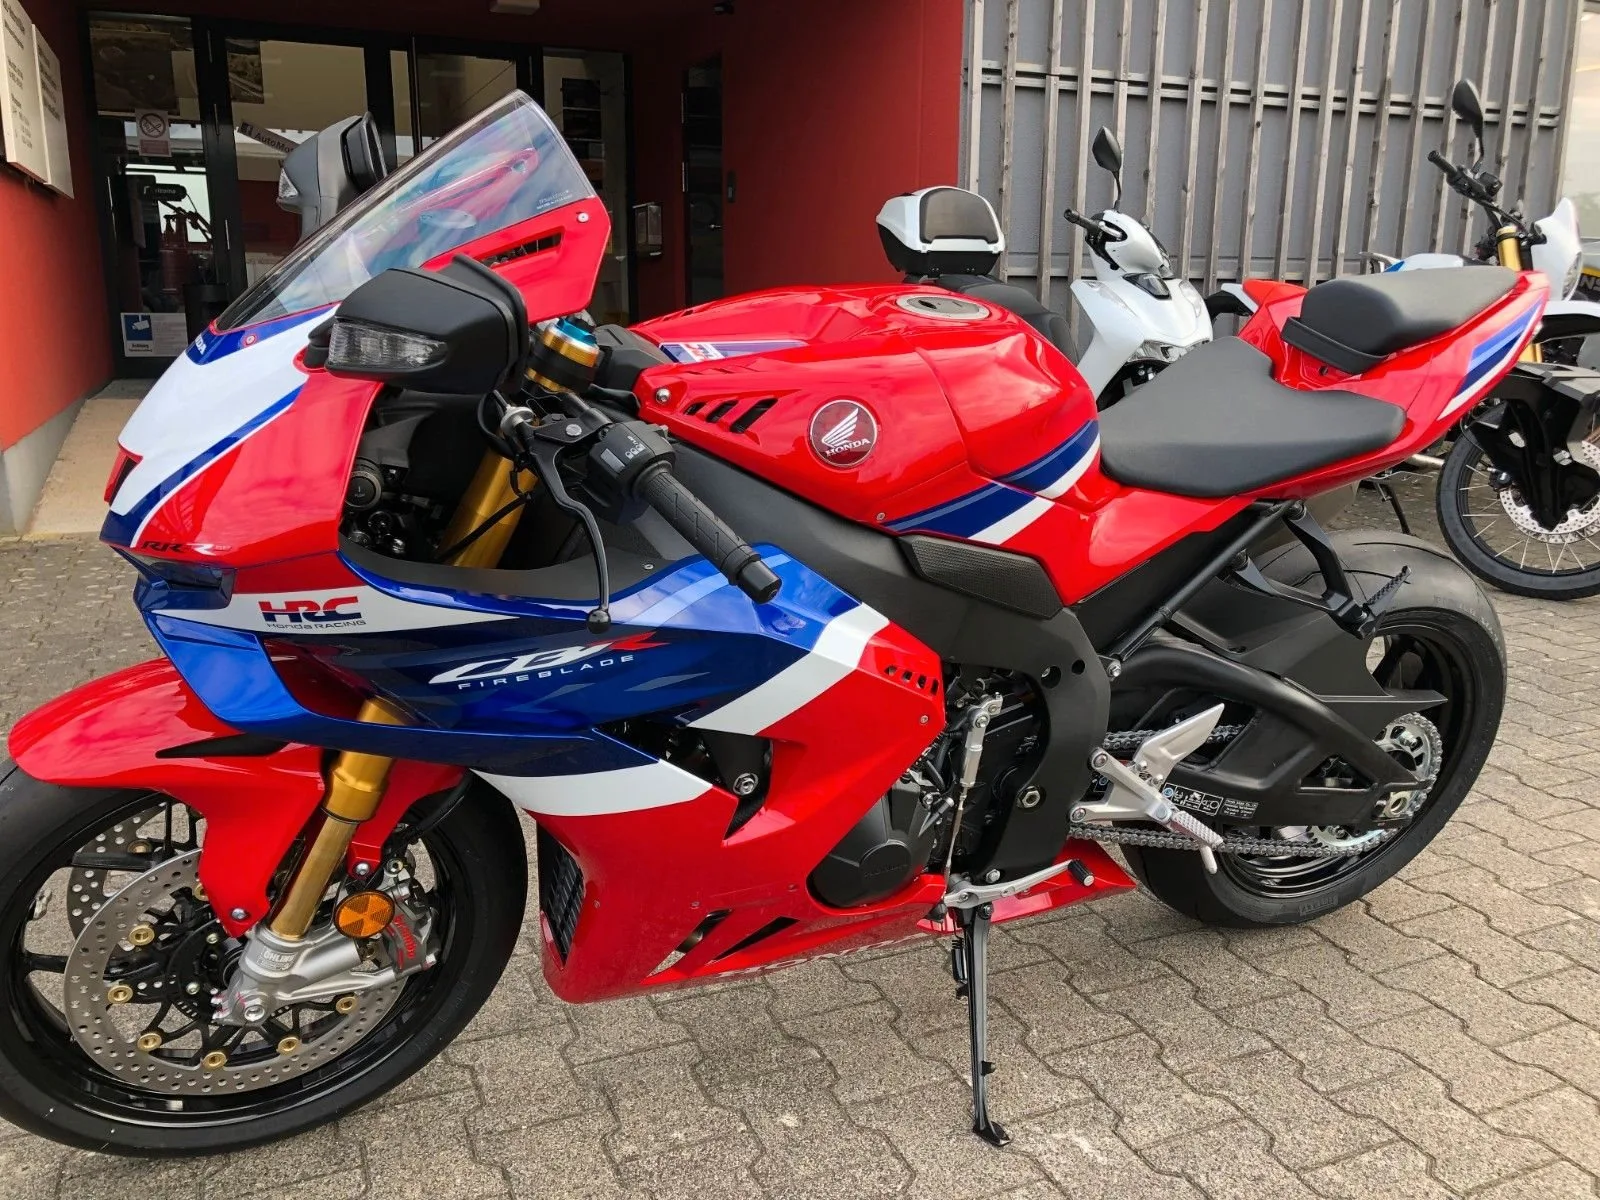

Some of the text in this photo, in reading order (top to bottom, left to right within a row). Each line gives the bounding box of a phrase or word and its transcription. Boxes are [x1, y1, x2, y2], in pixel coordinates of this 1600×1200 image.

[824, 438, 871, 457] HONDA
[258, 596, 362, 623] HRC
[267, 619, 366, 630] Honda RACING
[458, 654, 635, 690] FIREBLADE
